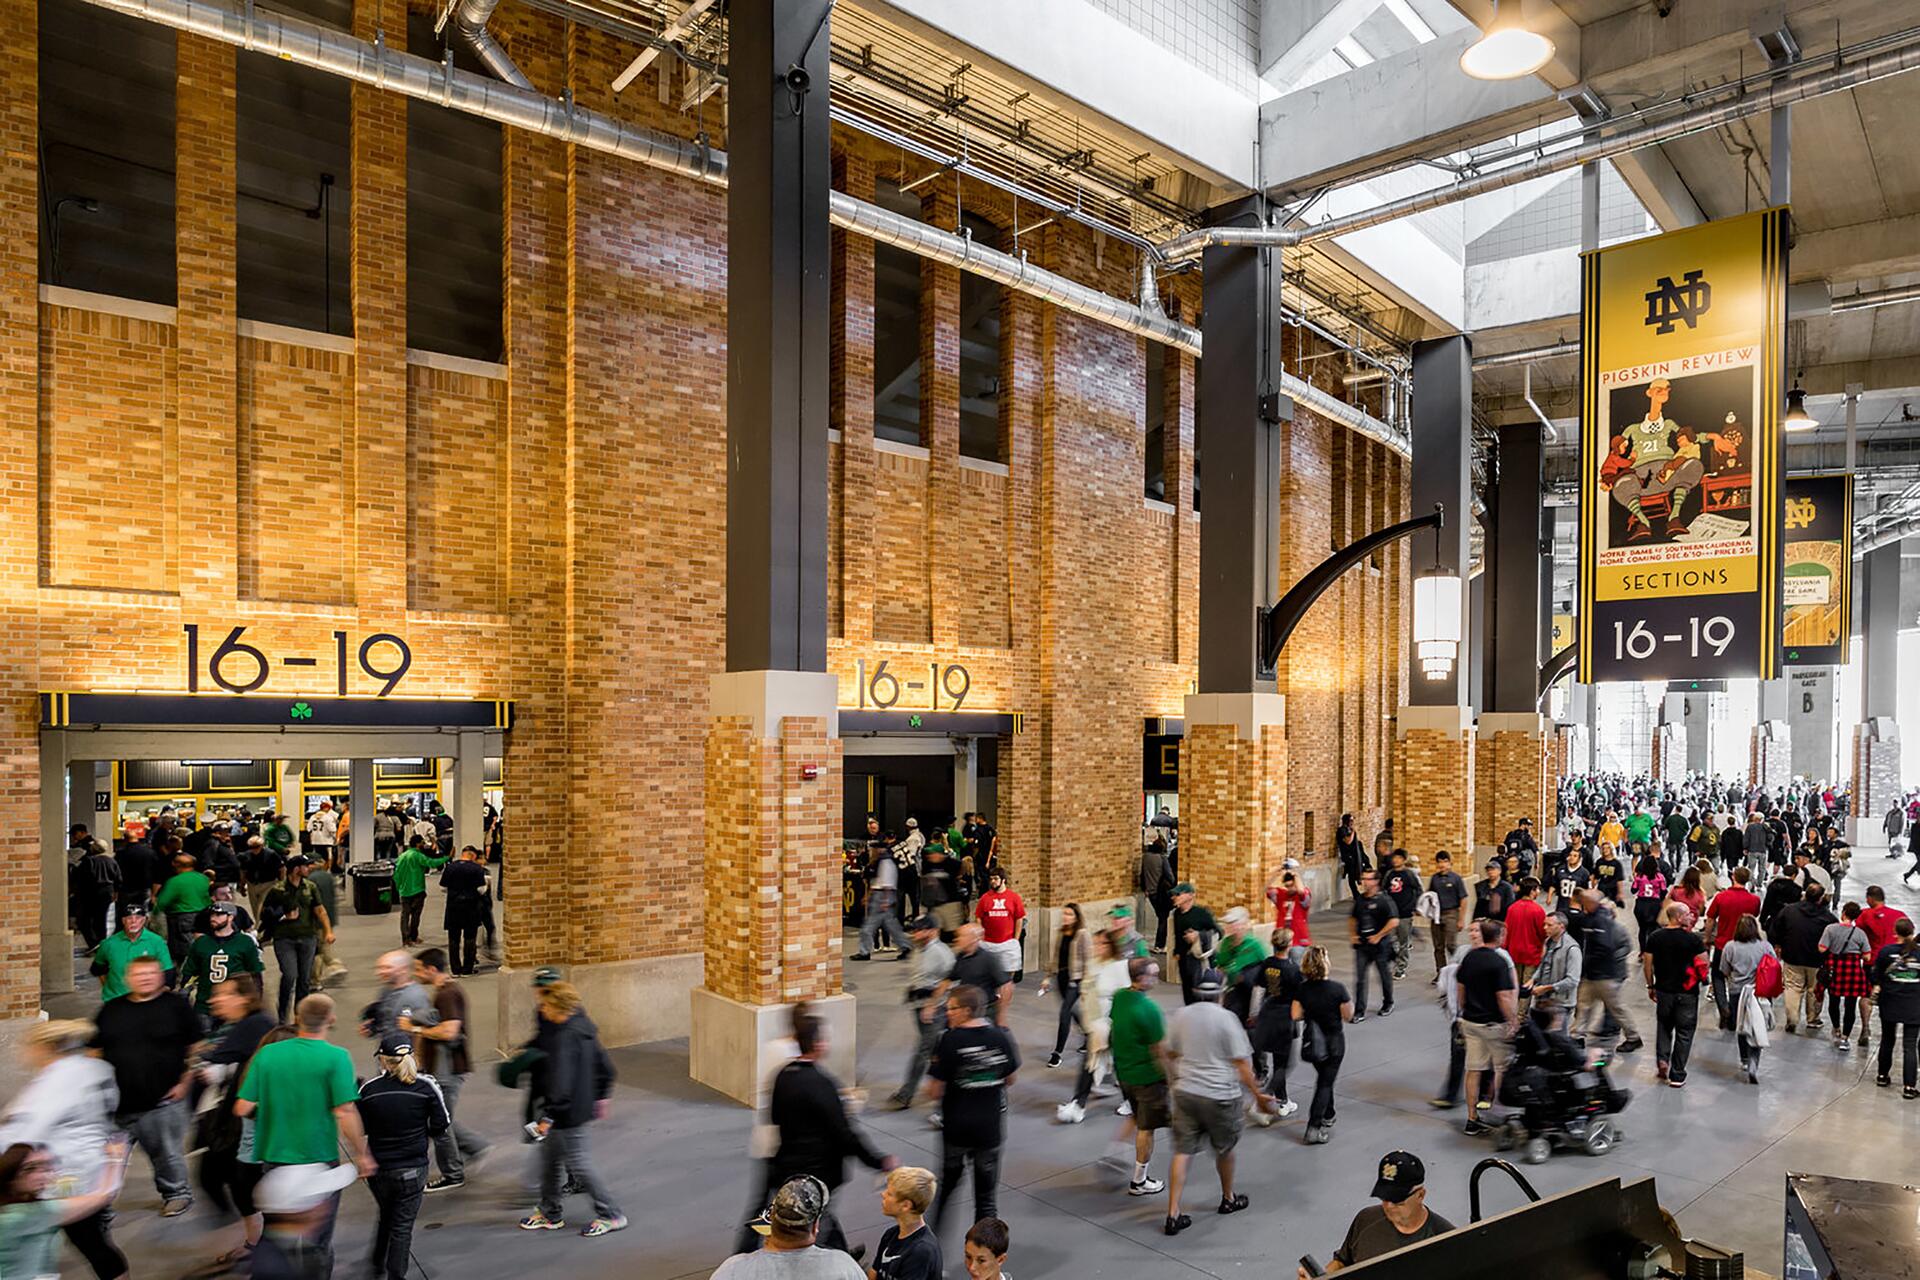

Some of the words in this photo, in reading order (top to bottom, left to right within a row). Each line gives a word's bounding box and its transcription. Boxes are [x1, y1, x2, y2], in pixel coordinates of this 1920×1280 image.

[1602, 363, 1670, 385] PIGSKIN
[1682, 347, 1753, 371] REVIEW
[1630, 548, 1652, 556] DAME
[1665, 543, 1704, 553] SOUTHERN
[1705, 540, 1751, 549] CALIFORNIA
[1600, 557, 1624, 565] HOME
[1627, 554, 1662, 563] COMING
[1622, 568, 1728, 590] SECTIONS
[1614, 616, 1735, 660] 16-19
[184, 624, 411, 697] 16-19
[858, 659, 970, 711] 16-19
[1803, 692, 1814, 713] B
[98, 794, 107, 803] 17
[1709, 833, 1716, 846] 9
[1560, 879, 1577, 897] 81
[1644, 884, 1653, 897] 5
[210, 954, 229, 983] 5
